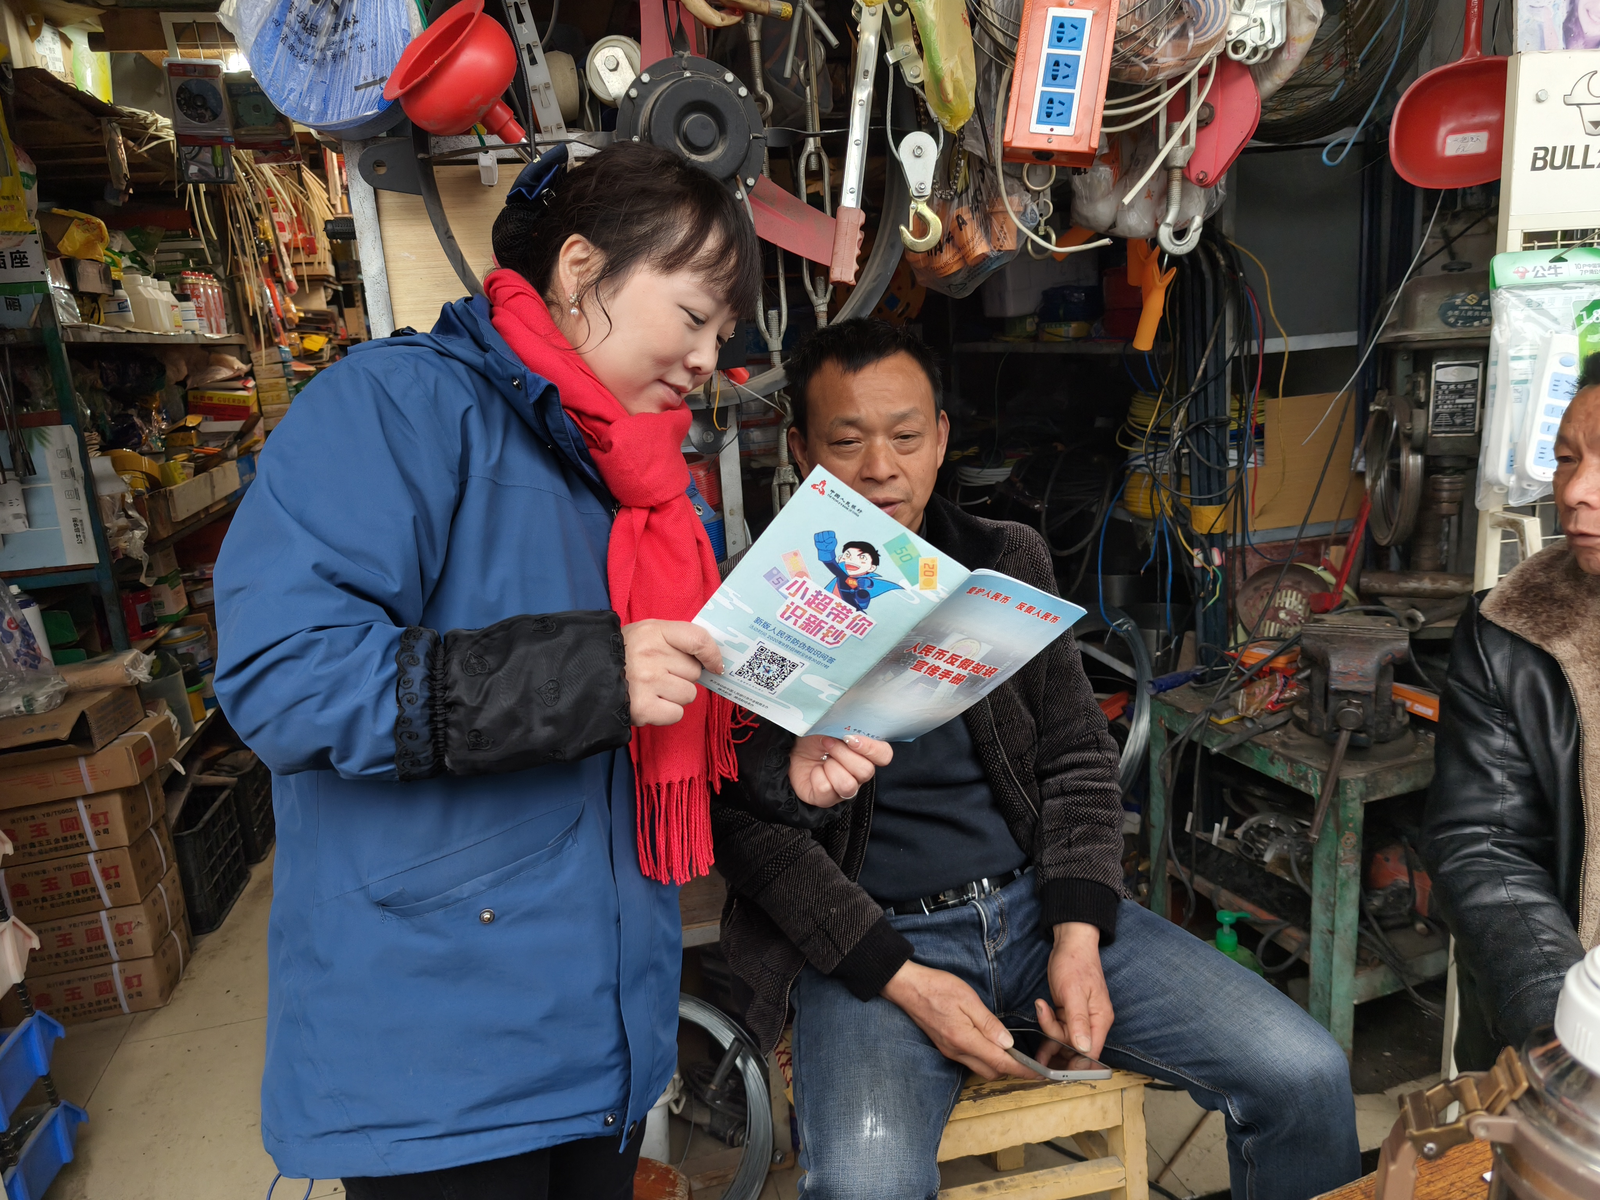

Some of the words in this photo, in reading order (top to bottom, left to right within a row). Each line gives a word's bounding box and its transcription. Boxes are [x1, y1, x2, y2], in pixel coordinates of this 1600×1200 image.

[1530, 145, 1600, 171] BULL
[1532, 264, 1563, 278] 公牛
[894, 546, 913, 563] 50
[924, 563, 934, 578] 20
[786, 580, 873, 636] 小超带你
[966, 586, 1012, 604] 爱护人民币
[1015, 602, 1062, 624] 反假人民币
[780, 602, 847, 646] 识新钞
[754, 616, 836, 664] 新版人民币防伪知识问答
[906, 642, 998, 678] 人民币反假知识
[910, 660, 968, 686] 宣传手册
